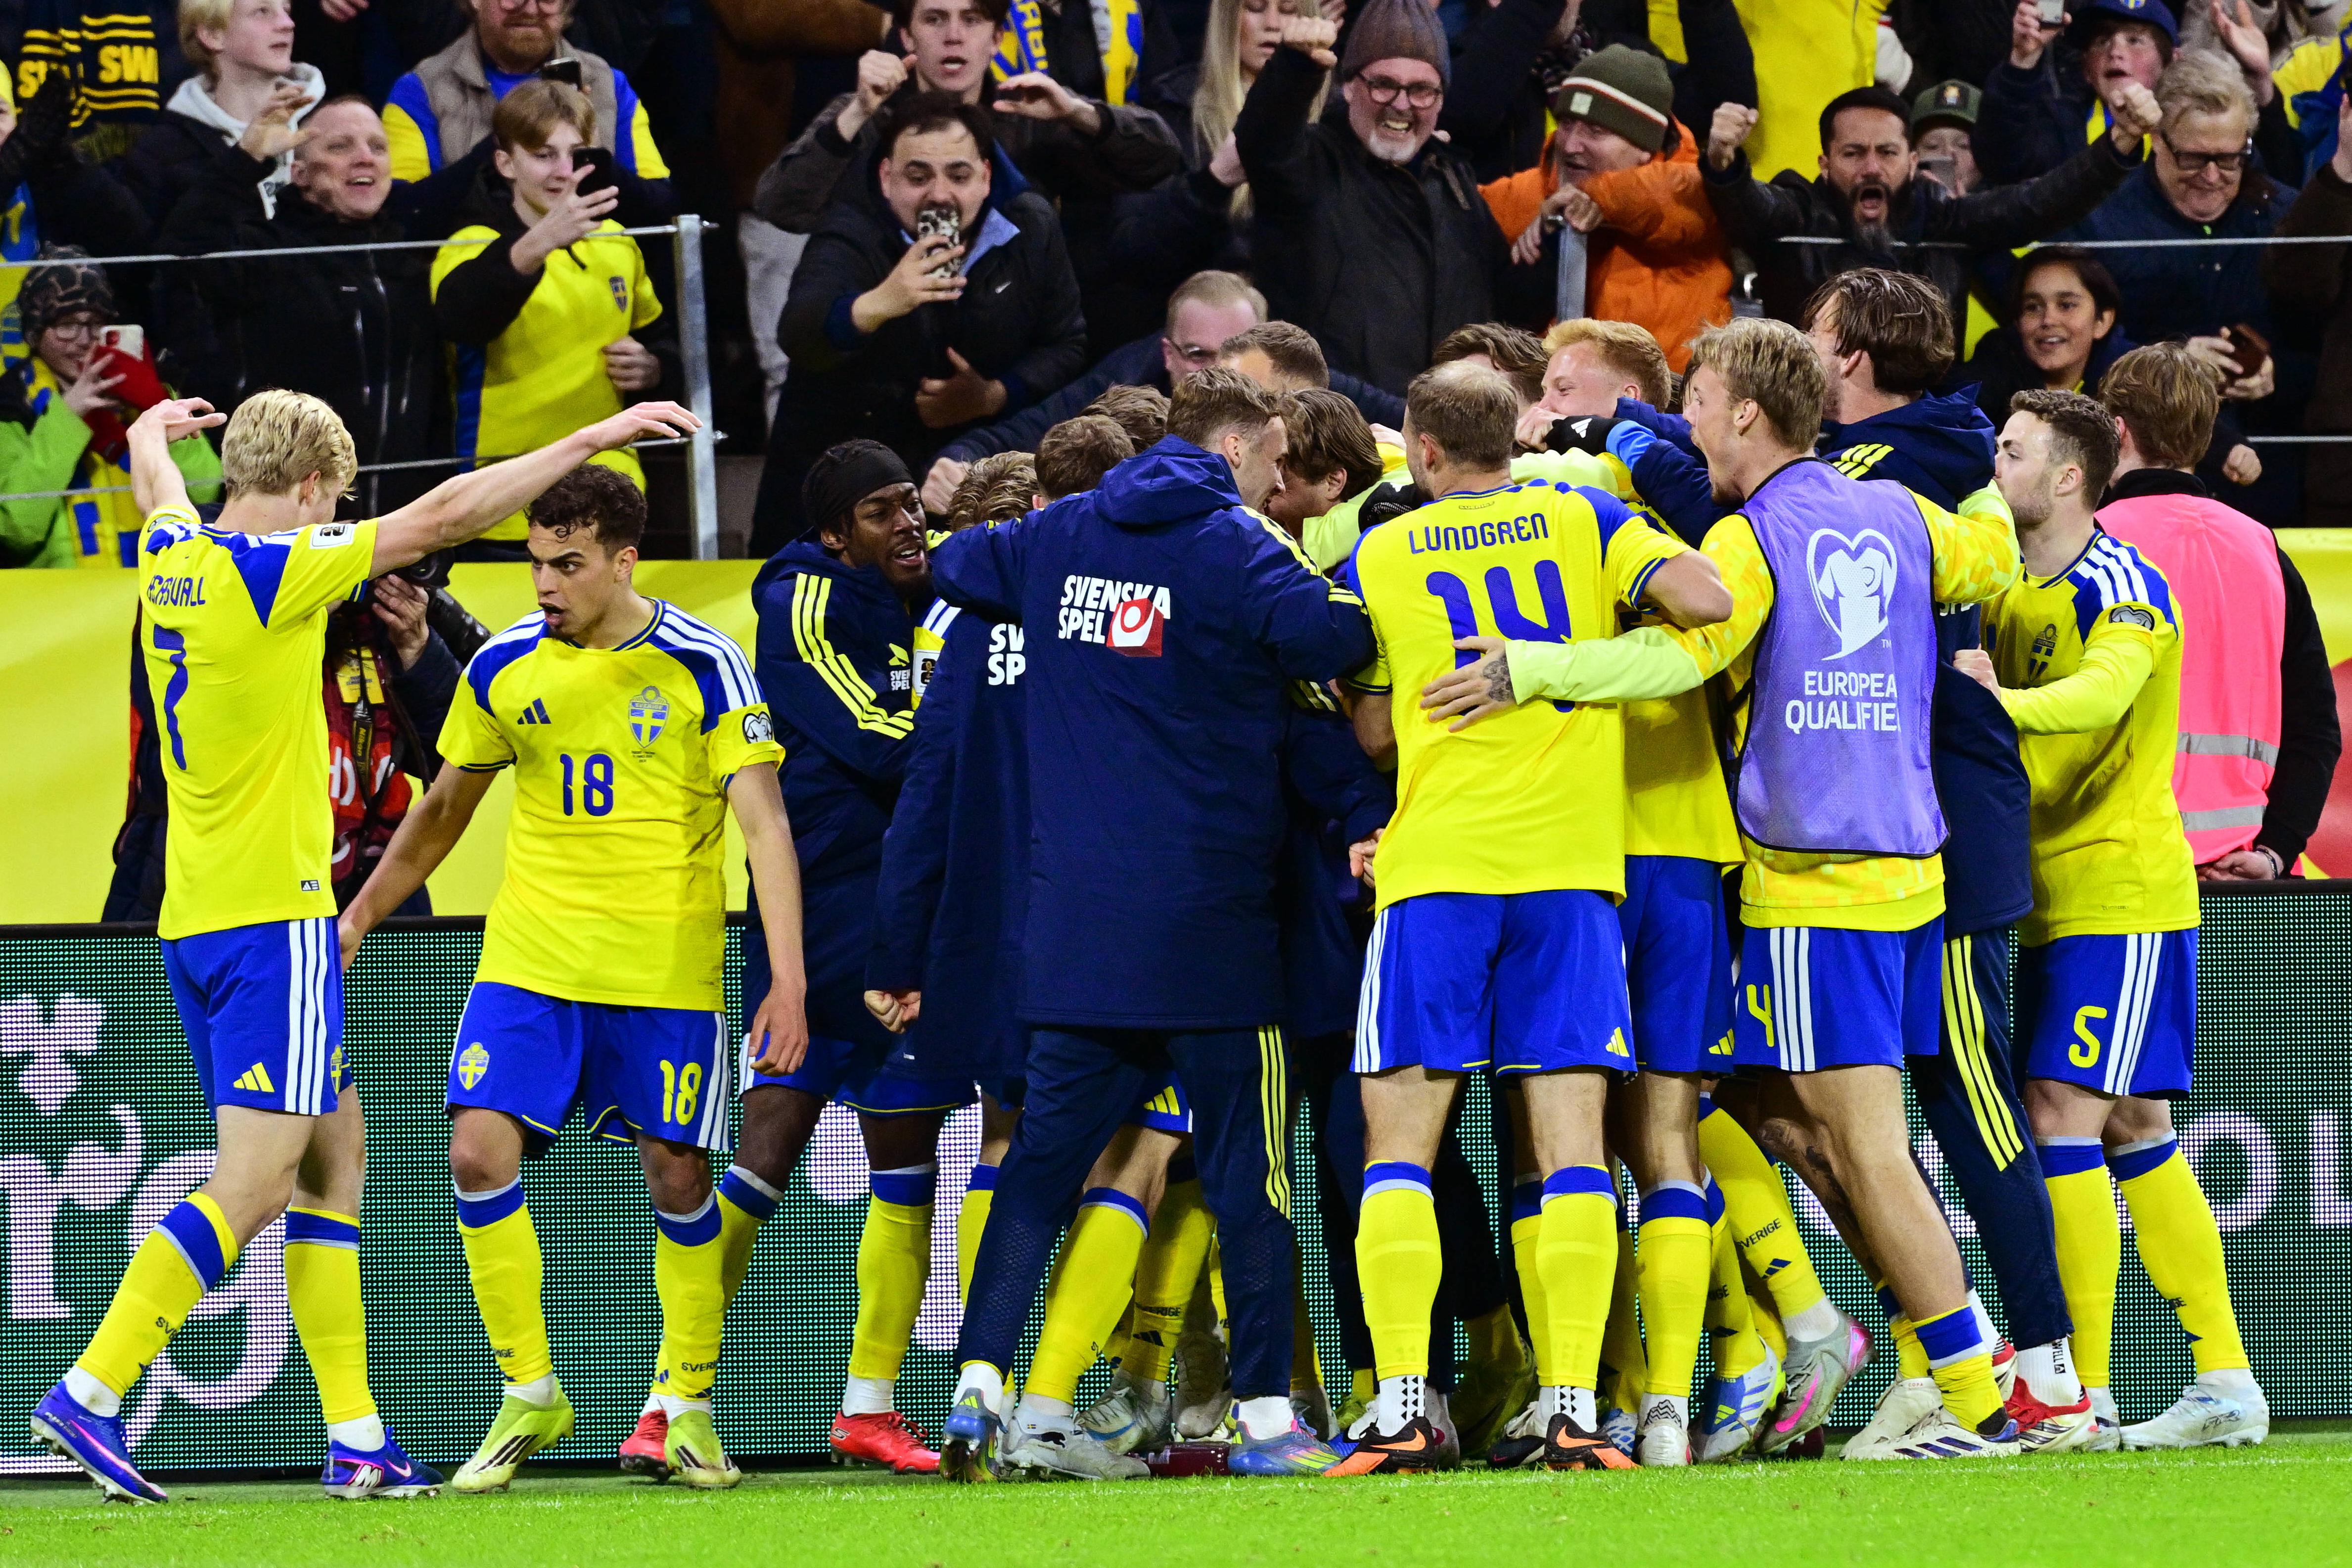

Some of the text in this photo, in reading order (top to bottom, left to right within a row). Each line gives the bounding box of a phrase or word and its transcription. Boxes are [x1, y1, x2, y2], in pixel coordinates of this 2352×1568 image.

[1409, 513, 1549, 554] LUNDGREN
[1058, 607, 1106, 644] SPEL
[1060, 575, 1171, 619] SVENSKA
[1426, 559, 1575, 716] 14
[153, 623, 188, 770] 7
[1785, 699, 1901, 735] QUALIFIE
[560, 753, 614, 816] 18
[1746, 983, 1775, 1048] 4
[2068, 1005, 2108, 1068] 5
[660, 1060, 702, 1126] 18
[1735, 1218, 1782, 1250] SVERIGE
